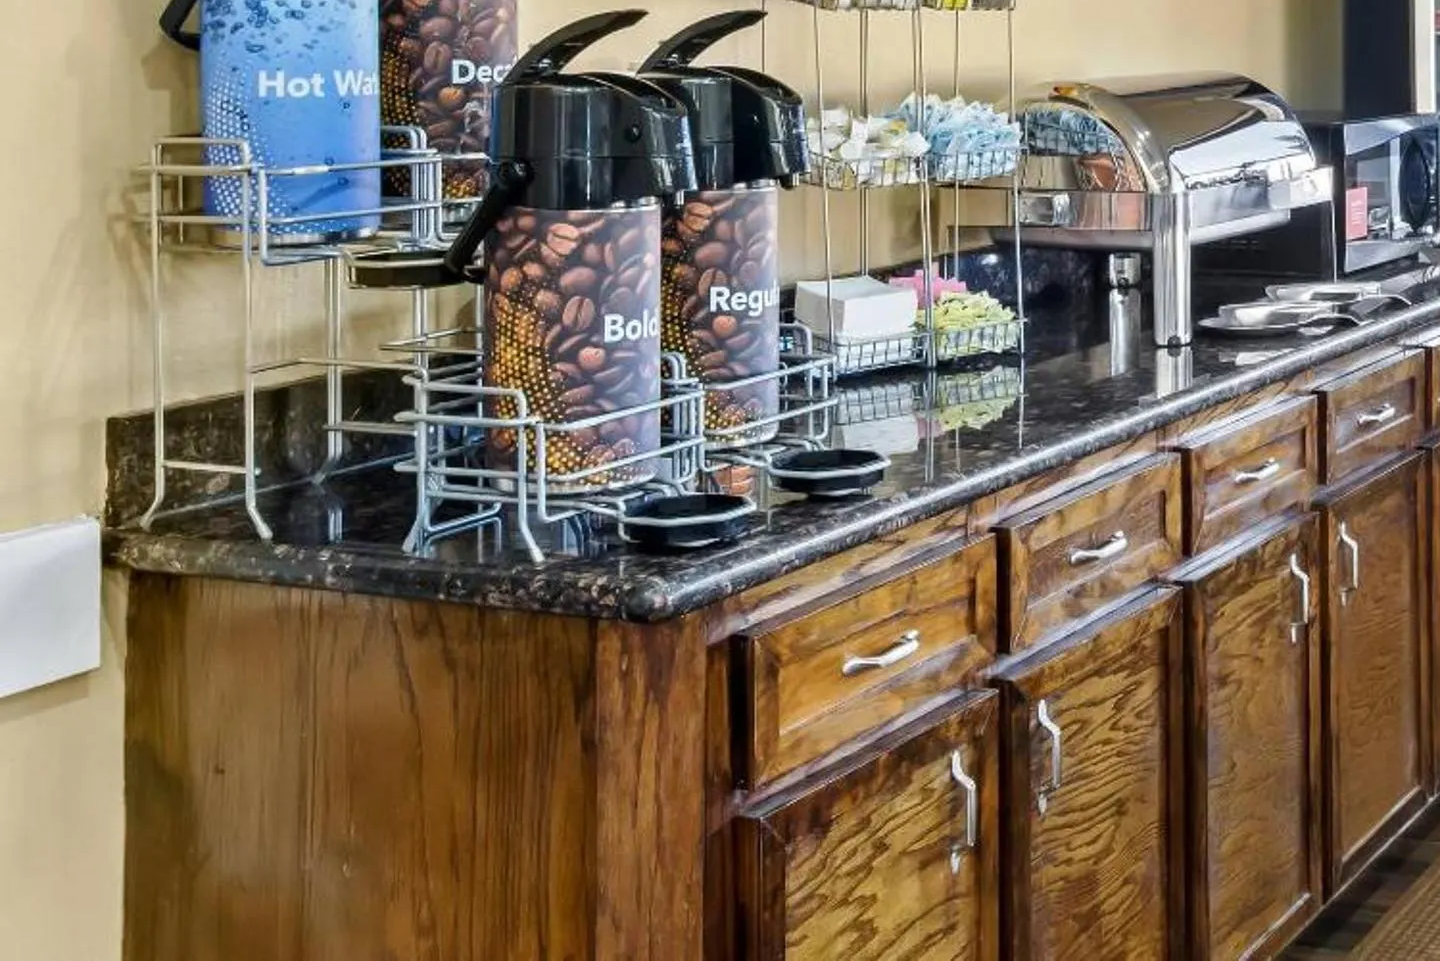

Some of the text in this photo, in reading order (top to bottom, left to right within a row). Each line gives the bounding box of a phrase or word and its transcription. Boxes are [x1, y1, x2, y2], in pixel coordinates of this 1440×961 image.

[258, 69, 325, 98] Hot
[452, 55, 517, 85] Dec
[604, 307, 660, 344] Bold
